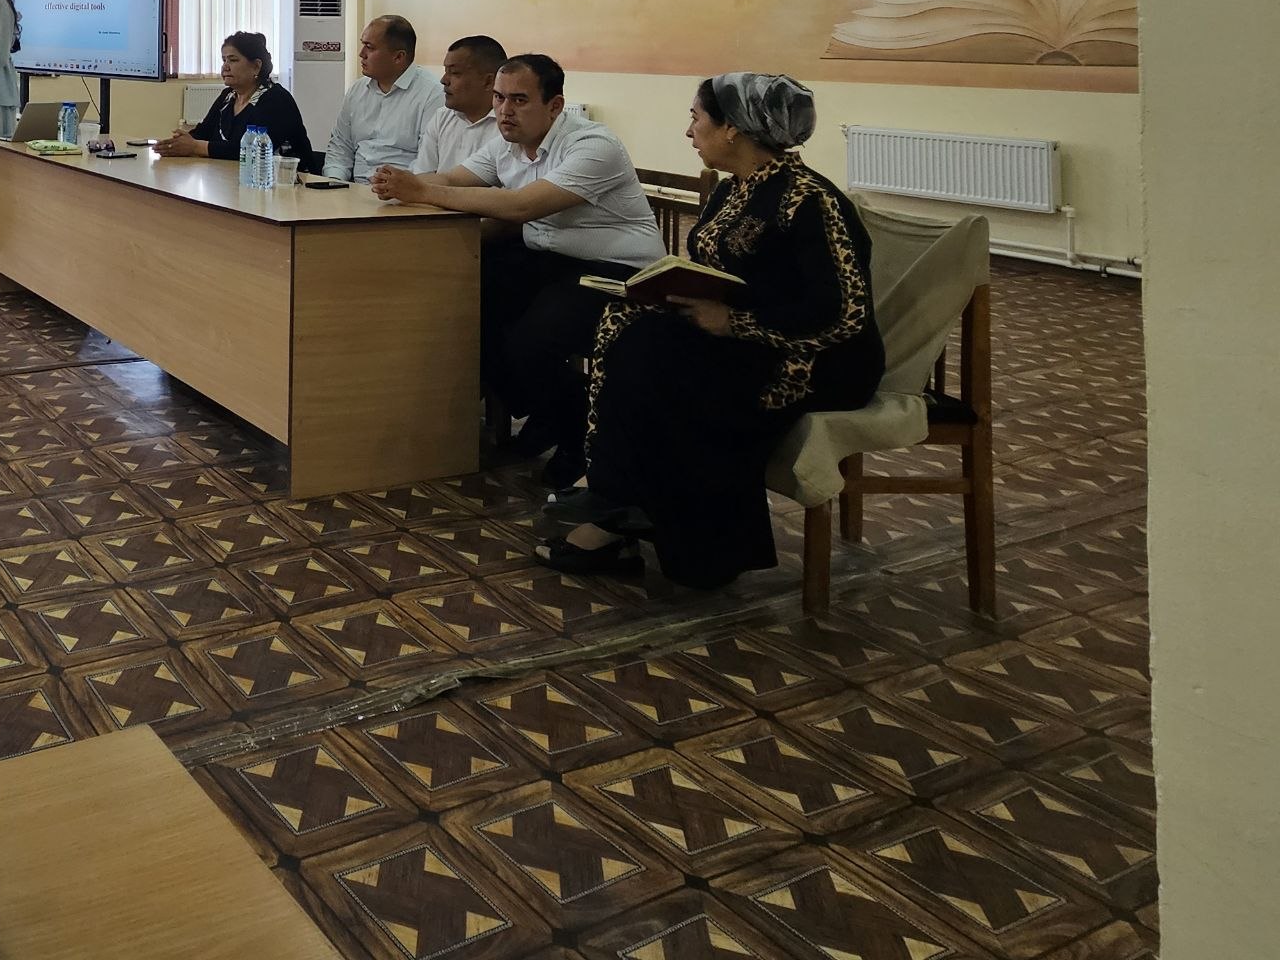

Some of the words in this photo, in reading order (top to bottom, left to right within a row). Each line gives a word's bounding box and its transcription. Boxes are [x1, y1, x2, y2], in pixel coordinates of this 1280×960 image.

[44, 2, 69, 11] effective
[69, 2, 90, 12] digital
[90, 2, 106, 11] tools
